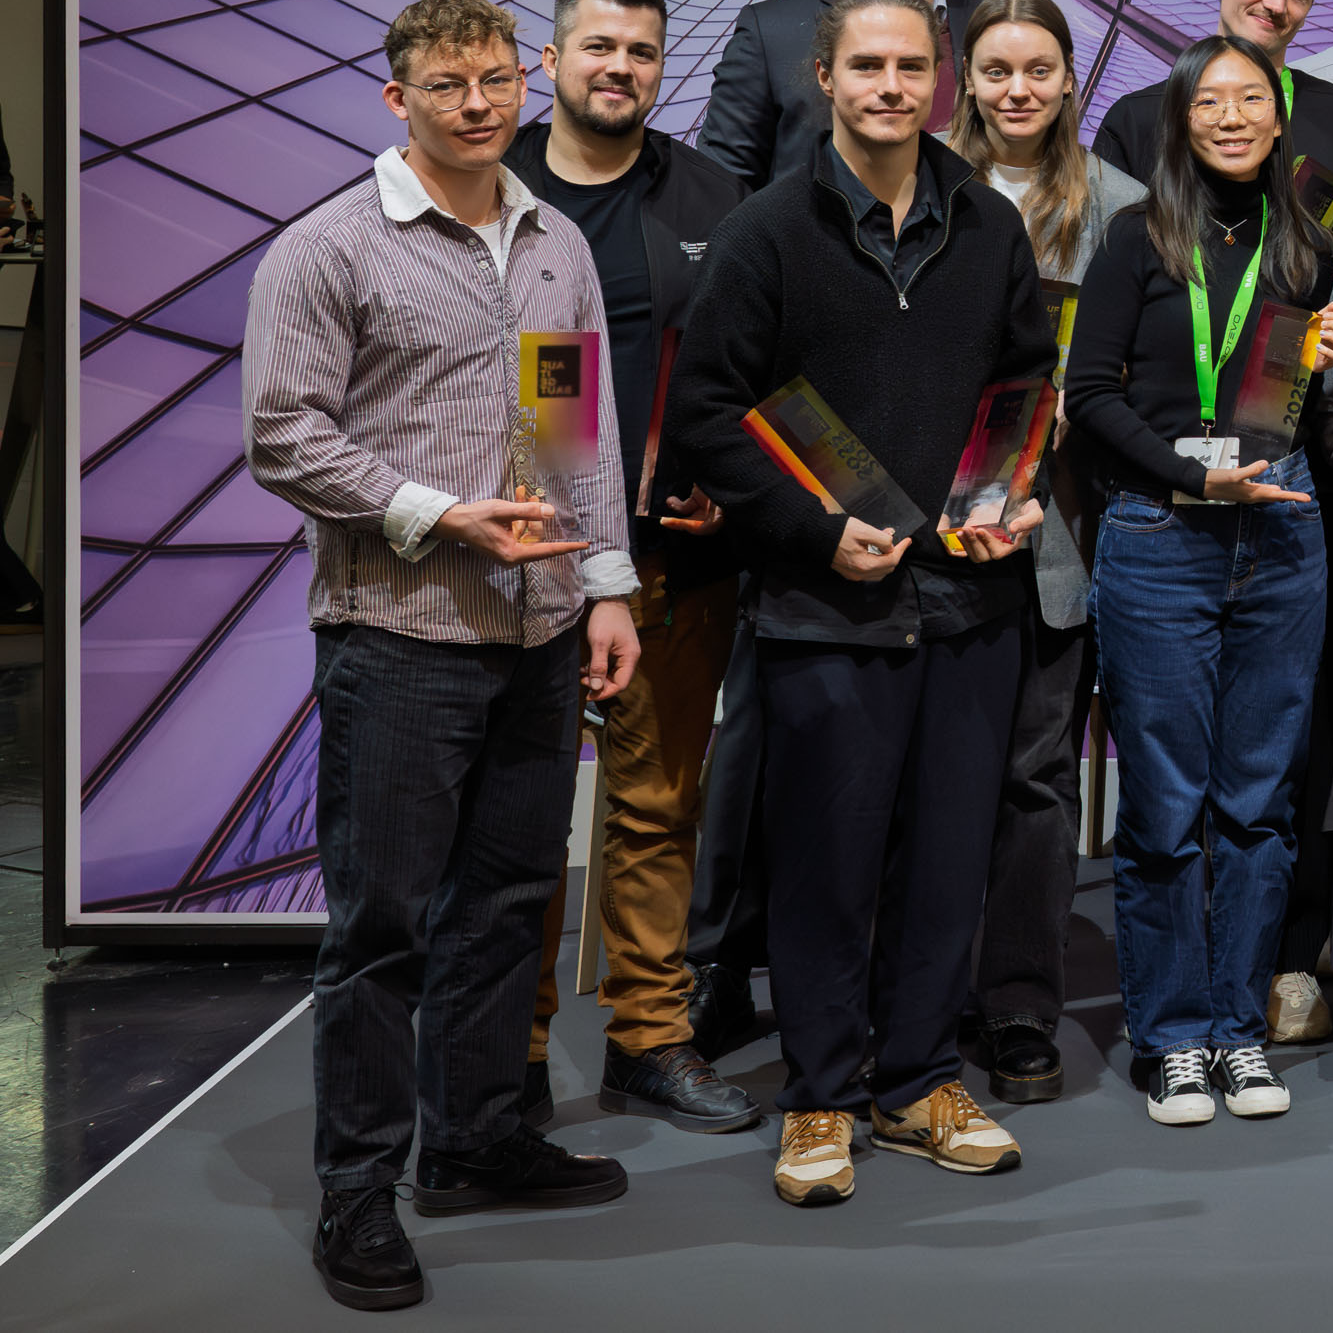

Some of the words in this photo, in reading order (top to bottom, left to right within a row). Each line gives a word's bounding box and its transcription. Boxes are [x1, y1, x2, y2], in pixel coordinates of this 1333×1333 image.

[1244, 271, 1255, 288] BAU
[1198, 343, 1208, 363] BAU
[1283, 375, 1309, 428] 2025
